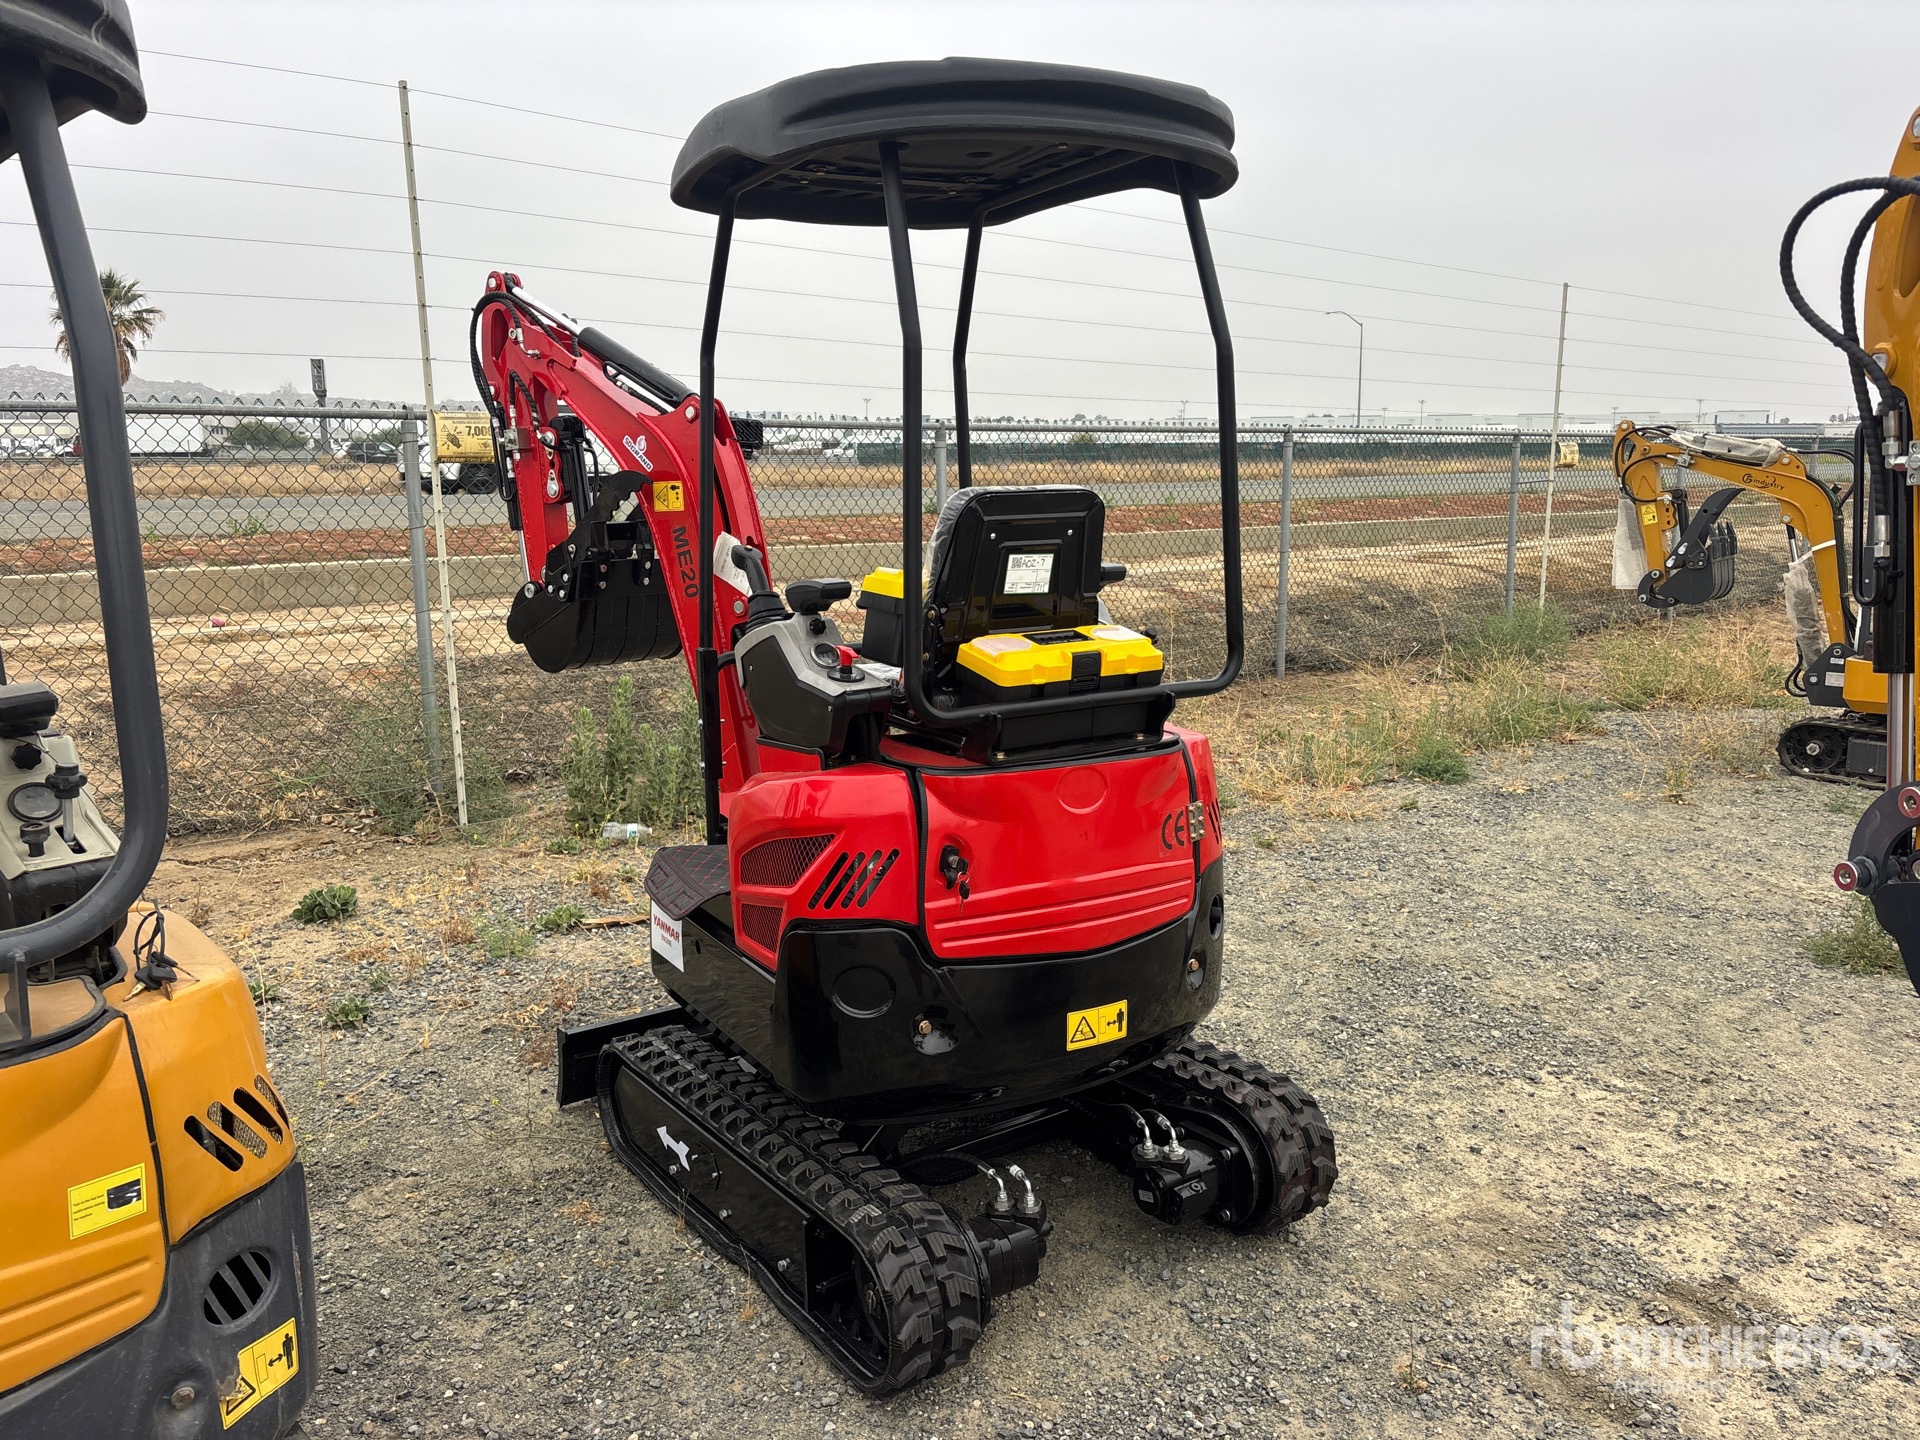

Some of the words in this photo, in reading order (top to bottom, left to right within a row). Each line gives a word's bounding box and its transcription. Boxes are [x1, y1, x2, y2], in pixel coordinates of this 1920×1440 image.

[672, 526, 699, 598] ME20
[1161, 810, 1185, 850] CE
[653, 914, 680, 943] YANMAR
